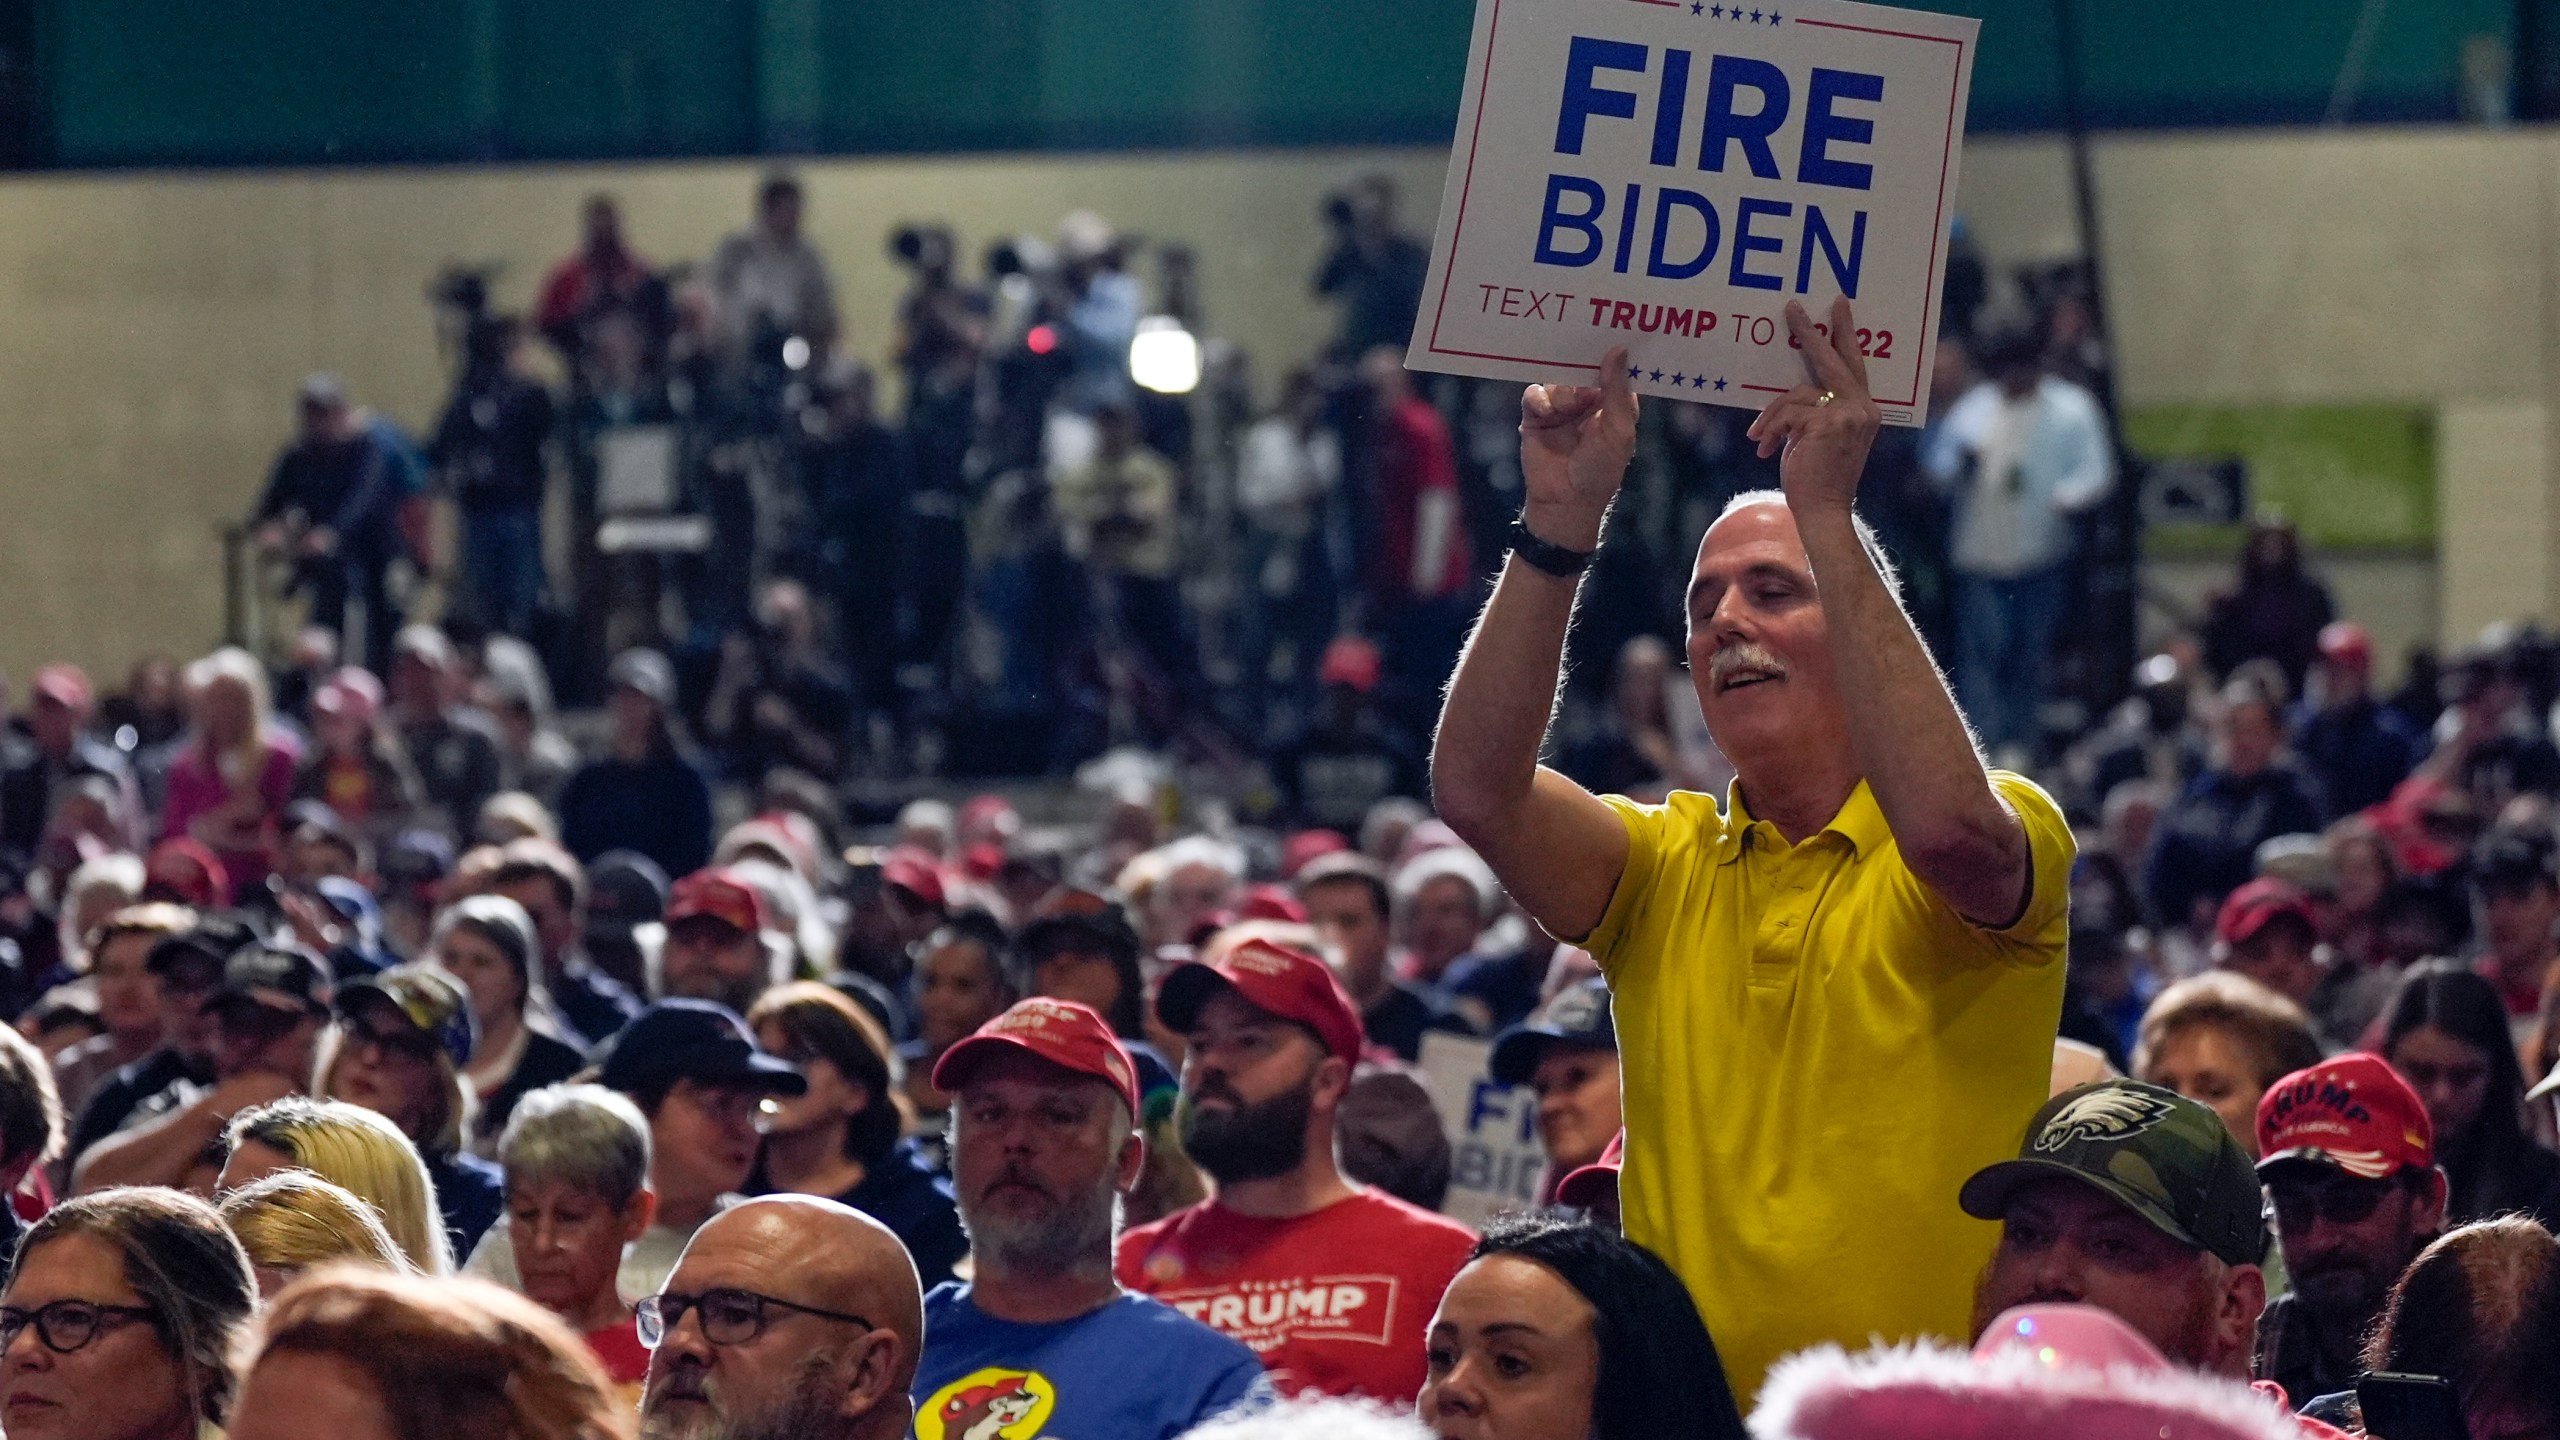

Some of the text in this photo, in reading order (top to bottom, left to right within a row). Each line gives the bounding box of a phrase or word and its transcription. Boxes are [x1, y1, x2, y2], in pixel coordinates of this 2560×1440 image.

[1554, 36, 1884, 190] FIRE
[1533, 173, 1867, 299] BIDEN
[1479, 284, 1575, 323] TEXT
[1588, 298, 1717, 339] TRUMP
[1731, 313, 1775, 346] TO
[1467, 1081, 1534, 1142] FI
[2266, 1081, 2370, 1131] TRUMP
[1453, 1142, 1544, 1200] BID
[1175, 1285, 1366, 1330] TRUMP
